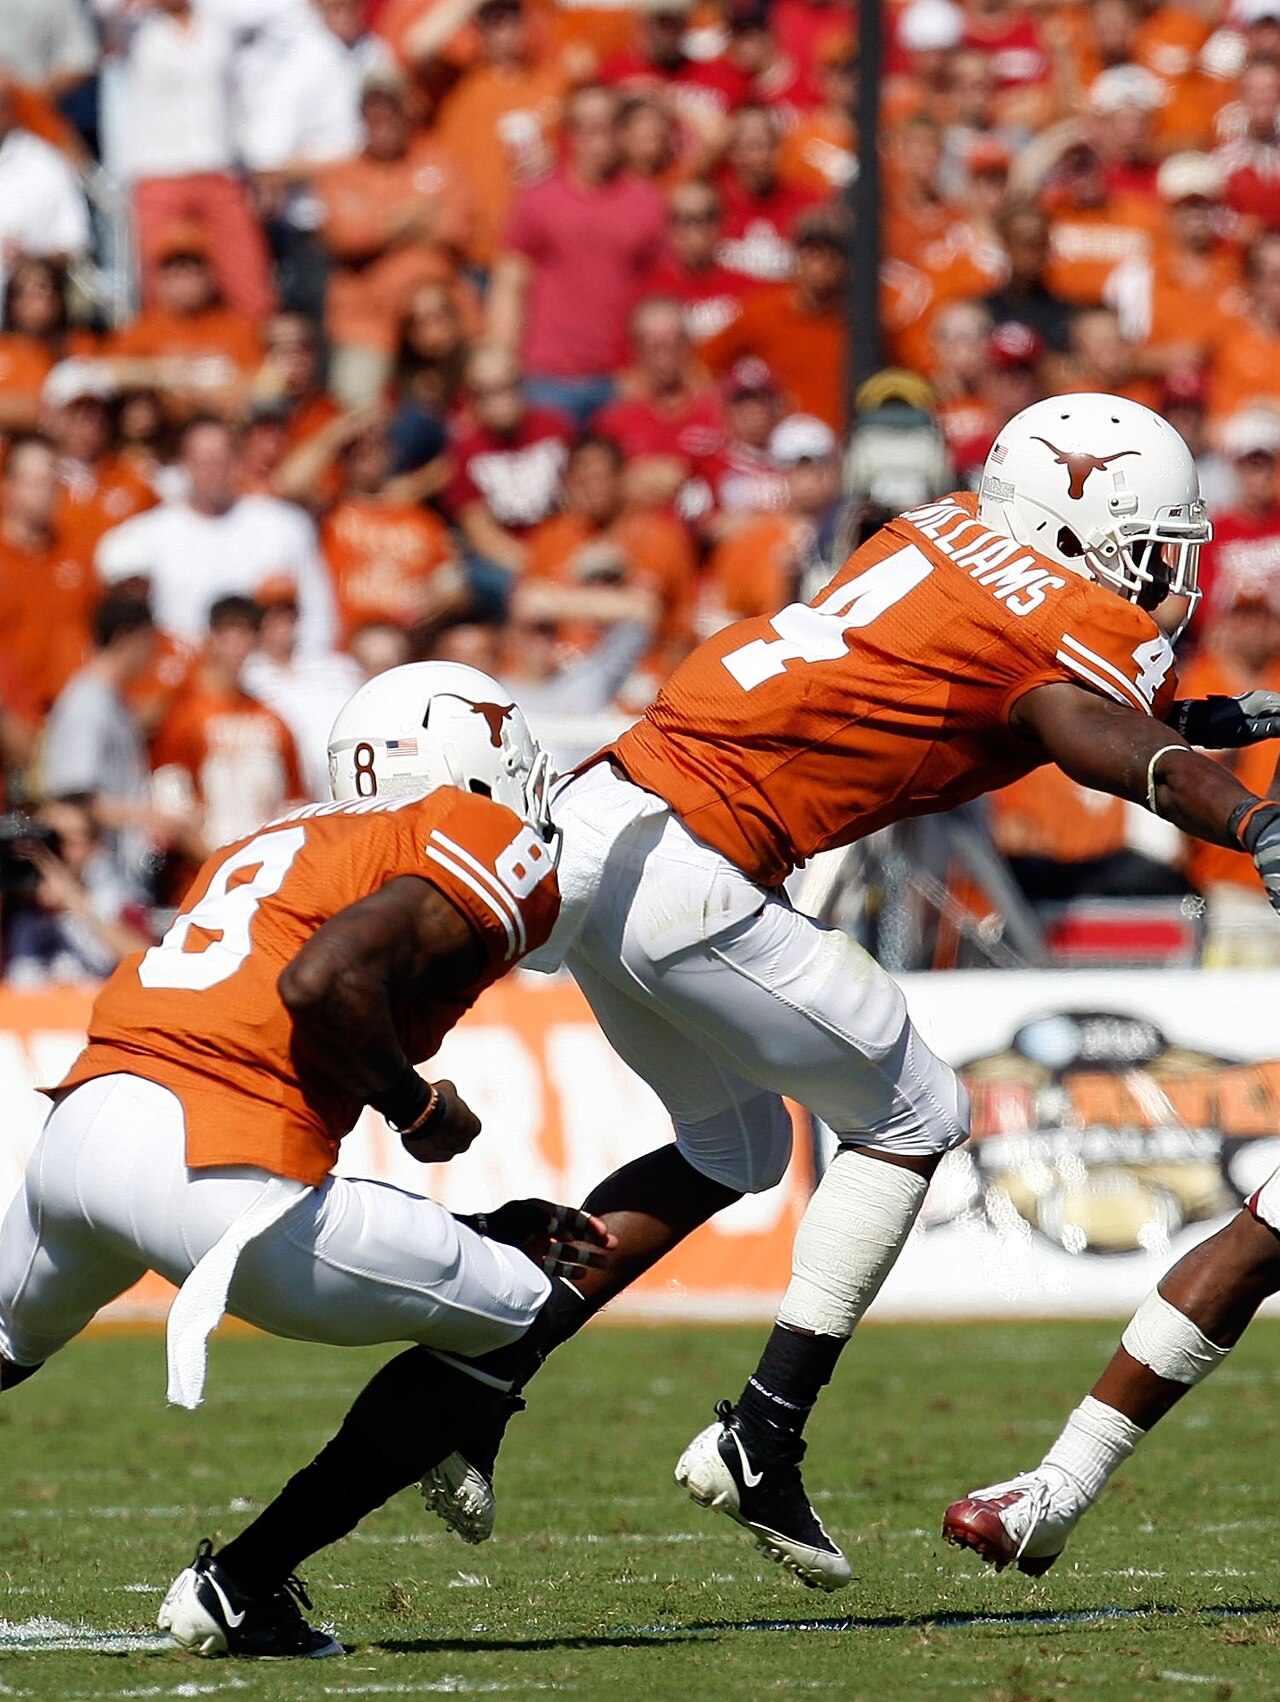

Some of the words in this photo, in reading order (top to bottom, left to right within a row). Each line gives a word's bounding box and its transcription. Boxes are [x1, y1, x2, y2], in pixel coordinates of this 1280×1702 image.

[720, 542, 936, 693] 4
[1131, 634, 1174, 705] 4
[354, 742, 378, 798] 8
[494, 825, 557, 899] 8
[137, 825, 307, 992] 8
